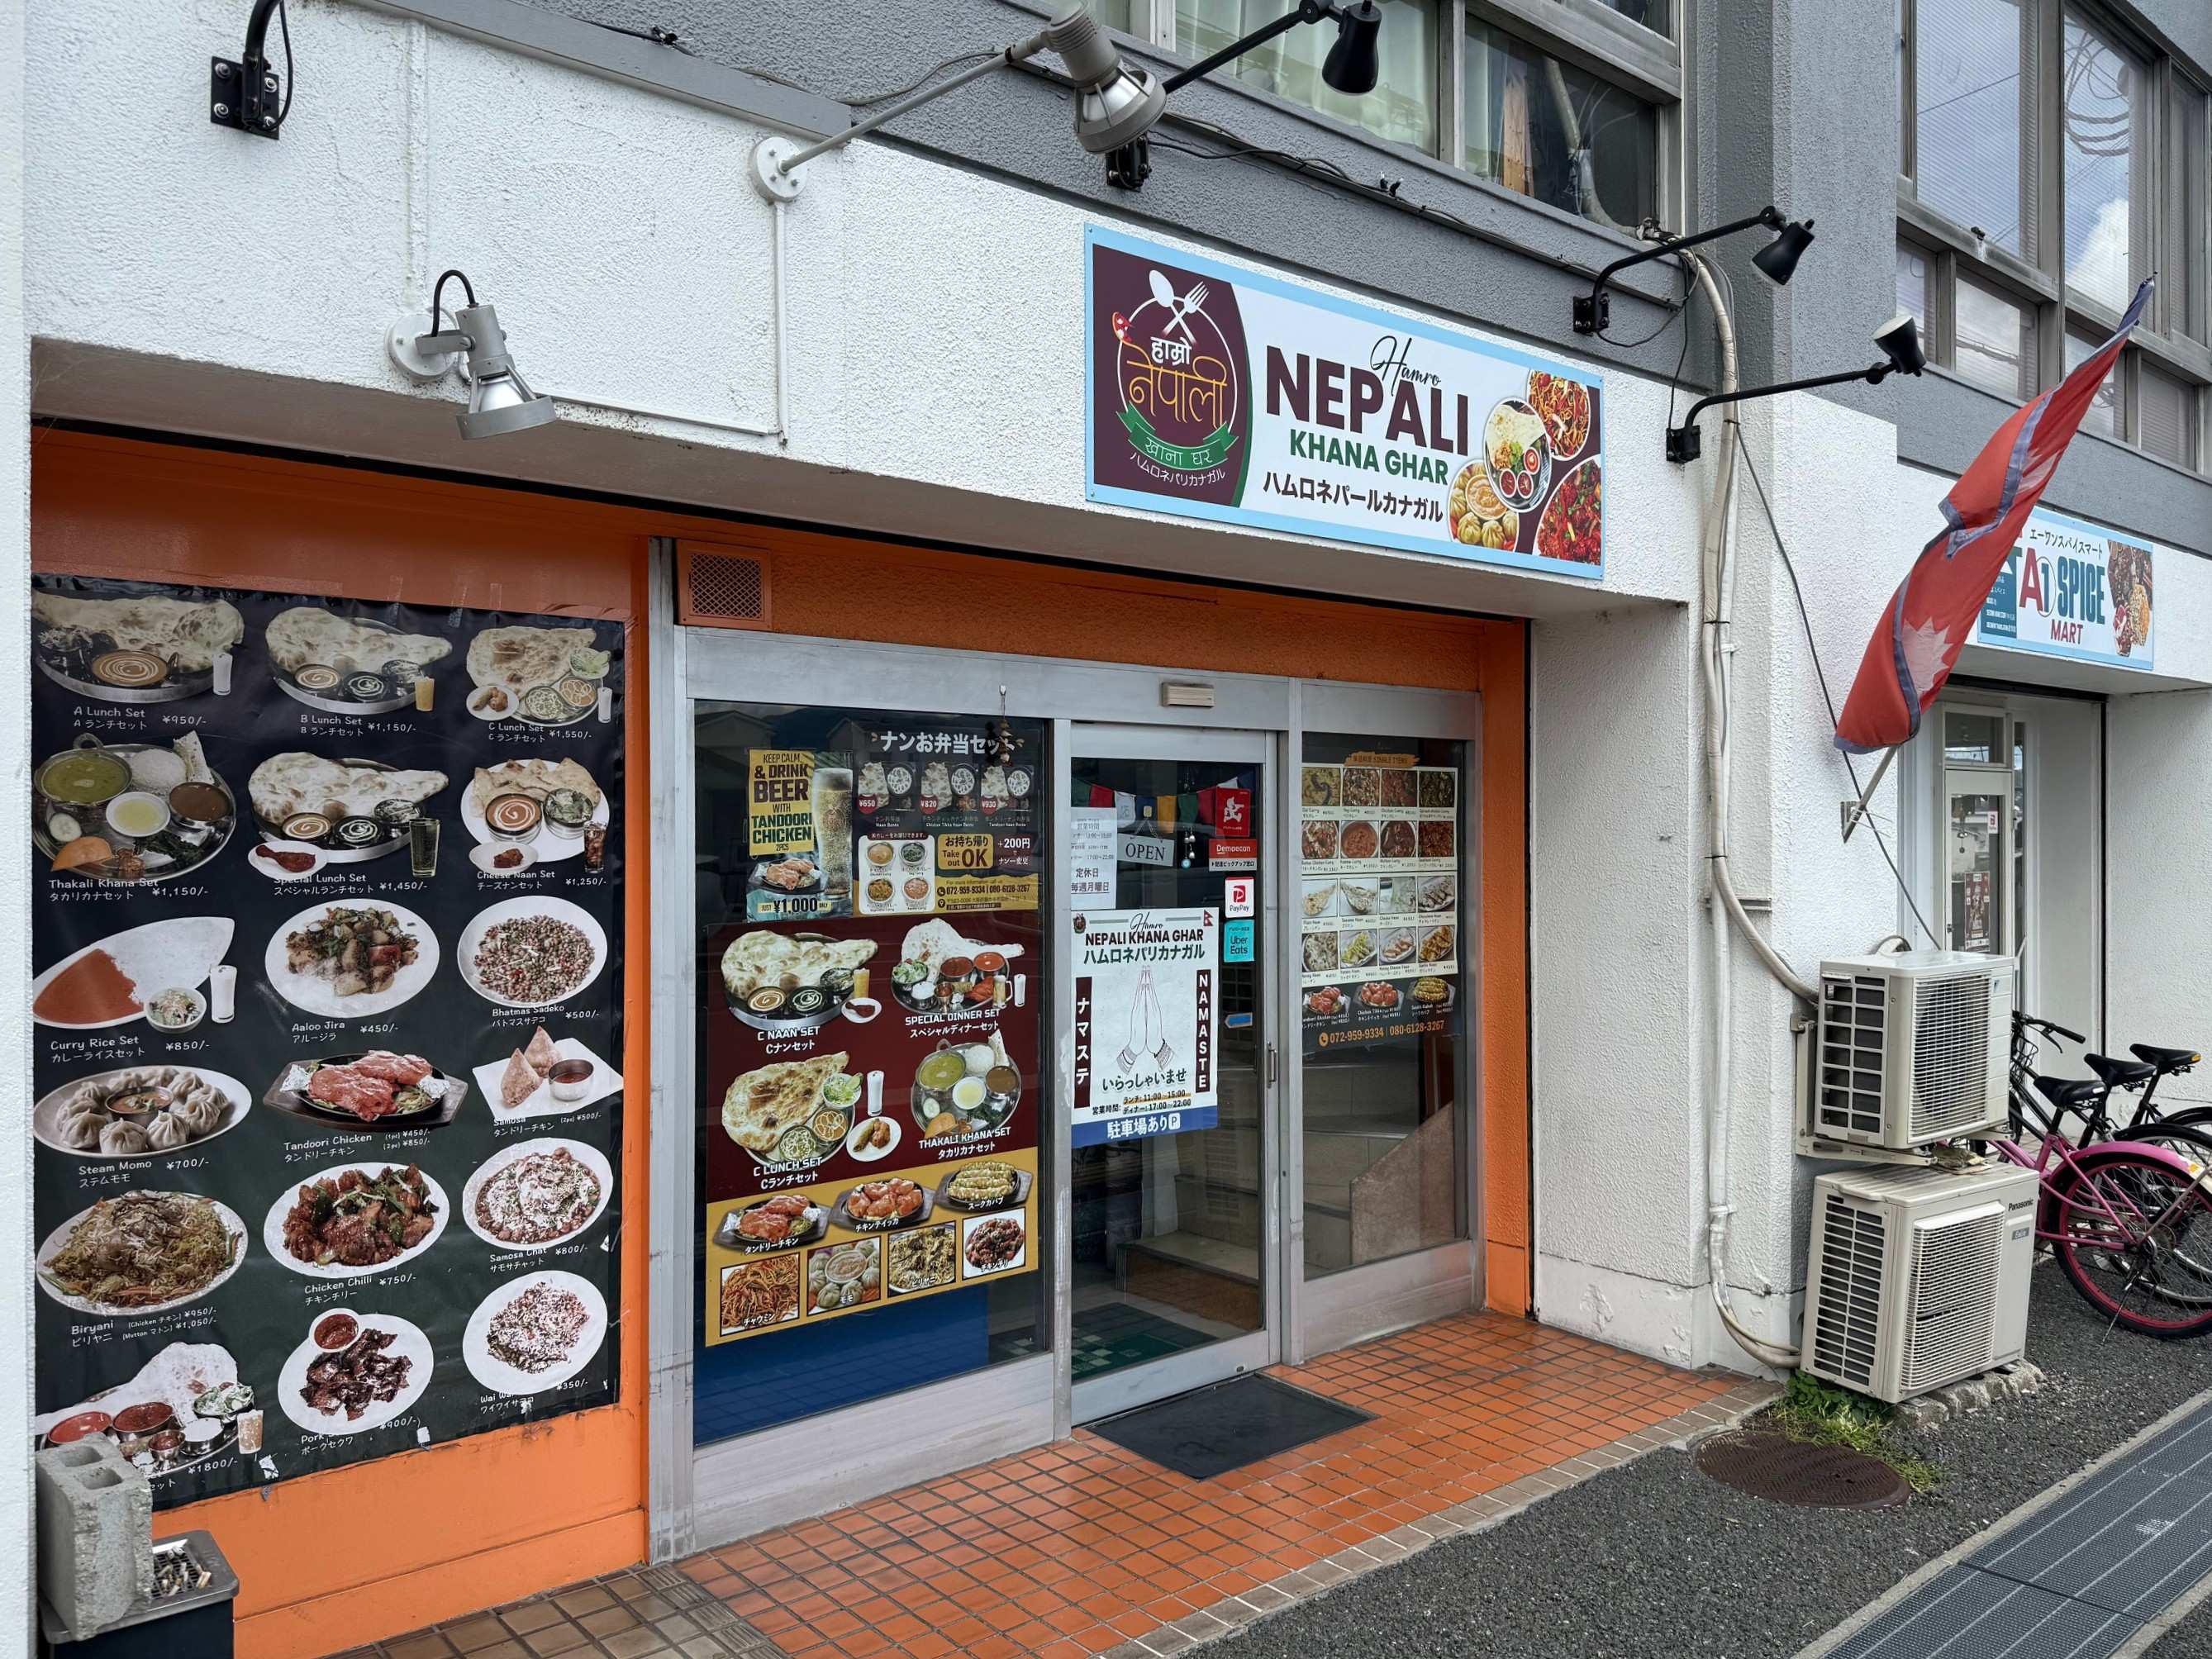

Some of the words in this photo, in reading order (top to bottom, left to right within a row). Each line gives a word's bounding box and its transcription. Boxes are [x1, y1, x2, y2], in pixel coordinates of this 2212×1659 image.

[1369, 335, 1442, 397] Hamro
[1124, 345, 1228, 430] नेपाली
[1266, 345, 1468, 457] NEPALI
[1144, 436, 1183, 466] खाना
[1191, 449, 1213, 465] घर
[1290, 429, 1380, 473] KHANA
[1385, 449, 1449, 485] GHAR
[1130, 452, 1225, 487] ハムロネパリカナガル
[1263, 472, 1444, 522] ハムロネパールカナガル
[2057, 556, 2105, 625] SPICE
[2050, 619, 2083, 644] MART
[74, 706, 83, 716] A
[87, 706, 121, 717] Lunch
[125, 708, 146, 718] Set
[85, 720, 148, 730] ランチセット
[162, 715, 207, 725] ¥950/-
[300, 715, 308, 724] B
[312, 715, 341, 725] Lunch
[345, 716, 362, 725] Set
[498, 723, 526, 731] Lunch
[311, 727, 364, 737] ランチセット
[368, 723, 416, 733] ¥1,150/-
[549, 730, 592, 739] ¥1,550/-
[497, 733, 545, 743] ランチセット
[763, 753, 781, 763] KEEP
[754, 765, 766, 779] &
[768, 763, 809, 778] DRINK
[754, 778, 809, 803] BEER
[772, 803, 792, 813] WITH
[859, 800, 876, 808] ¥650
[920, 800, 937, 808] ¥820
[981, 800, 997, 808] ¥930
[751, 813, 812, 829] TANDOORI
[753, 826, 811, 844] CHICKEN
[945, 835, 988, 847] お持ち帰り
[941, 850, 960, 858] Take
[961, 849, 988, 868] OK
[1125, 842, 1166, 861] OPEN
[316, 874, 346, 883] Lunch
[350, 873, 366, 882] Set
[540, 870, 555, 878] Set
[1075, 868, 1099, 878] 定休日
[49, 878, 93, 889] Thakali
[98, 877, 136, 888] Khana
[139, 877, 159, 887] Set
[379, 882, 428, 891] ¥1,450/-
[477, 882, 543, 890] チーズナンセット
[565, 877, 607, 887] ¥1,250/-
[1070, 882, 1110, 893] 毎週月曜日
[50, 891, 133, 902] タカリカナセット
[152, 887, 209, 897] ¥1,150/-
[274, 885, 374, 896] スペシャルランチセット
[773, 897, 817, 914] ¥1,000
[1130, 911, 1163, 934] Hamro
[1085, 932, 1126, 946] NEPALI
[1129, 930, 1170, 944] KHANA
[1173, 929, 1204, 942] GHAR
[1230, 935, 1249, 944] Uber
[1083, 944, 1206, 964] ハムロネパリカナガル
[1230, 945, 1249, 954] Eats
[492, 1007, 530, 1017] Bhatmas
[533, 1005, 565, 1014] Sadeko
[564, 1010, 600, 1020] ¥500/-
[905, 1014, 944, 1025] SPECIAL
[947, 1010, 982, 1021] DINNER
[984, 1008, 1001, 1017] SET
[292, 1022, 321, 1033] Aaloo
[324, 1020, 345, 1030] Jira
[359, 1023, 398, 1034] ¥450/-
[757, 1031, 764, 1041] C
[767, 1028, 798, 1040] NAAN
[800, 1025, 821, 1037] SET
[910, 1020, 998, 1038] スペシャルディナーセット
[1197, 974, 1209, 1088] NAMASTE
[1330, 1027, 1384, 1043] 072-959-9334
[1389, 1020, 1445, 1036] 080-6128-3267
[50, 1040, 85, 1051] Curry
[89, 1038, 116, 1047] Rice
[119, 1036, 140, 1045] Set
[165, 1040, 210, 1052] ¥850/-
[765, 1039, 816, 1054] Cナンセット
[1076, 997, 1090, 1085] ナマステ
[52, 1047, 145, 1063] カレーライスセット
[1102, 1067, 1187, 1091] いらっしゃいませ
[494, 1123, 555, 1138] タンドリーチキン
[918, 1134, 959, 1149] THAKALI
[961, 1129, 993, 1142] KHANA
[994, 1126, 1011, 1137] SET
[283, 1138, 330, 1151] Tandoori
[332, 1134, 372, 1145] Chicken
[284, 1147, 355, 1163] タンドリーチキン
[938, 1141, 996, 1160] タカリカナセット
[78, 1165, 115, 1177] Steam
[119, 1161, 152, 1171] Momo
[166, 1157, 210, 1170] ¥700/-
[753, 1166, 760, 1177] C
[763, 1162, 800, 1175] LUNCH
[802, 1156, 823, 1167] SET
[78, 1173, 131, 1189] ステムモモ
[760, 1170, 818, 1190] Cランチセット
[2008, 1198, 2034, 1212] Panasonic
[554, 1244, 588, 1256] ¥800/-
[744, 1237, 799, 1255] タンドリーチキン
[489, 1252, 524, 1262] Samosa
[526, 1248, 548, 1257] Chat
[490, 1258, 545, 1272] サモサチャット
[304, 1281, 345, 1295] Chicken
[347, 1274, 372, 1287] Chilli
[379, 1273, 417, 1286] ¥750/-
[305, 1290, 358, 1306] チキンチリー
[184, 1306, 216, 1318] ¥950/-
[71, 1319, 114, 1338] Biryani
[175, 1316, 216, 1329] ¥1,050/-
[480, 1393, 496, 1404] Wai
[301, 1433, 324, 1444] Pork
[188, 1457, 239, 1475] ¥1800/-
